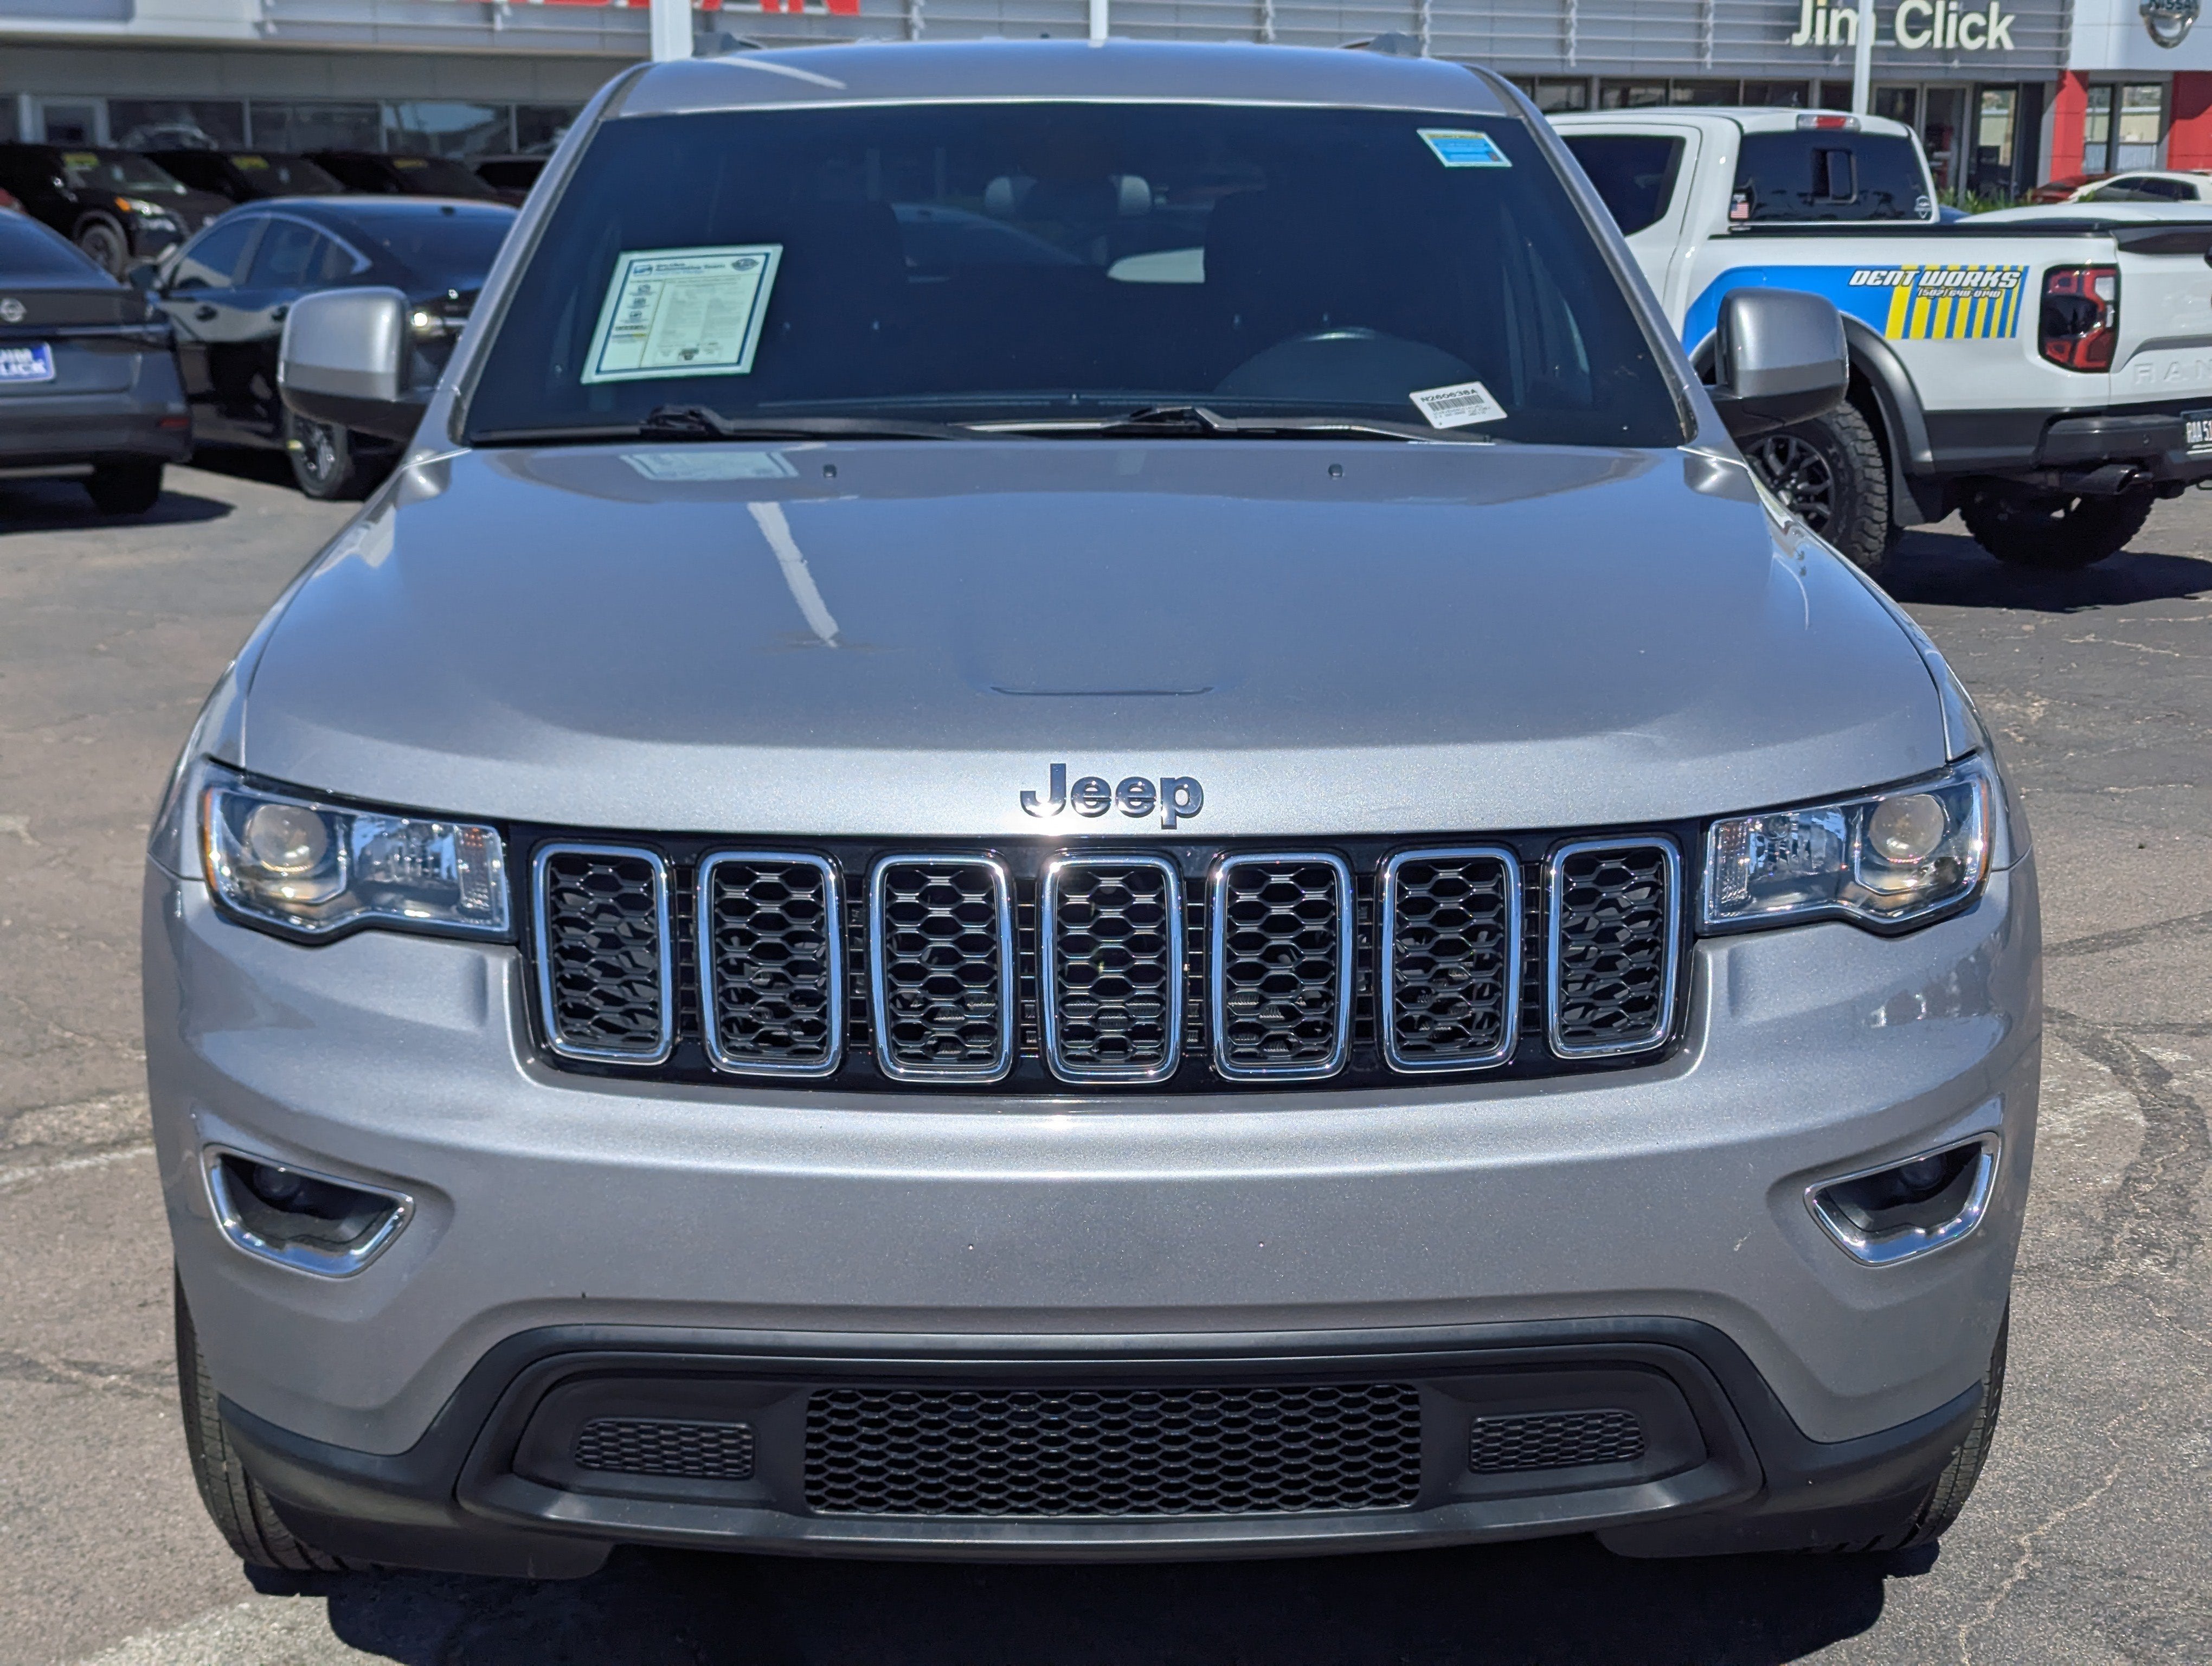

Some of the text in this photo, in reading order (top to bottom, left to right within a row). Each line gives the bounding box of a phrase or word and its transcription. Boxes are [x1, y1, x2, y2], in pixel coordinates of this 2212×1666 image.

[1791, 0, 2016, 50] Jim Click
[1918, 270, 2021, 288] WORKS
[1020, 763, 1204, 830] Jeep
